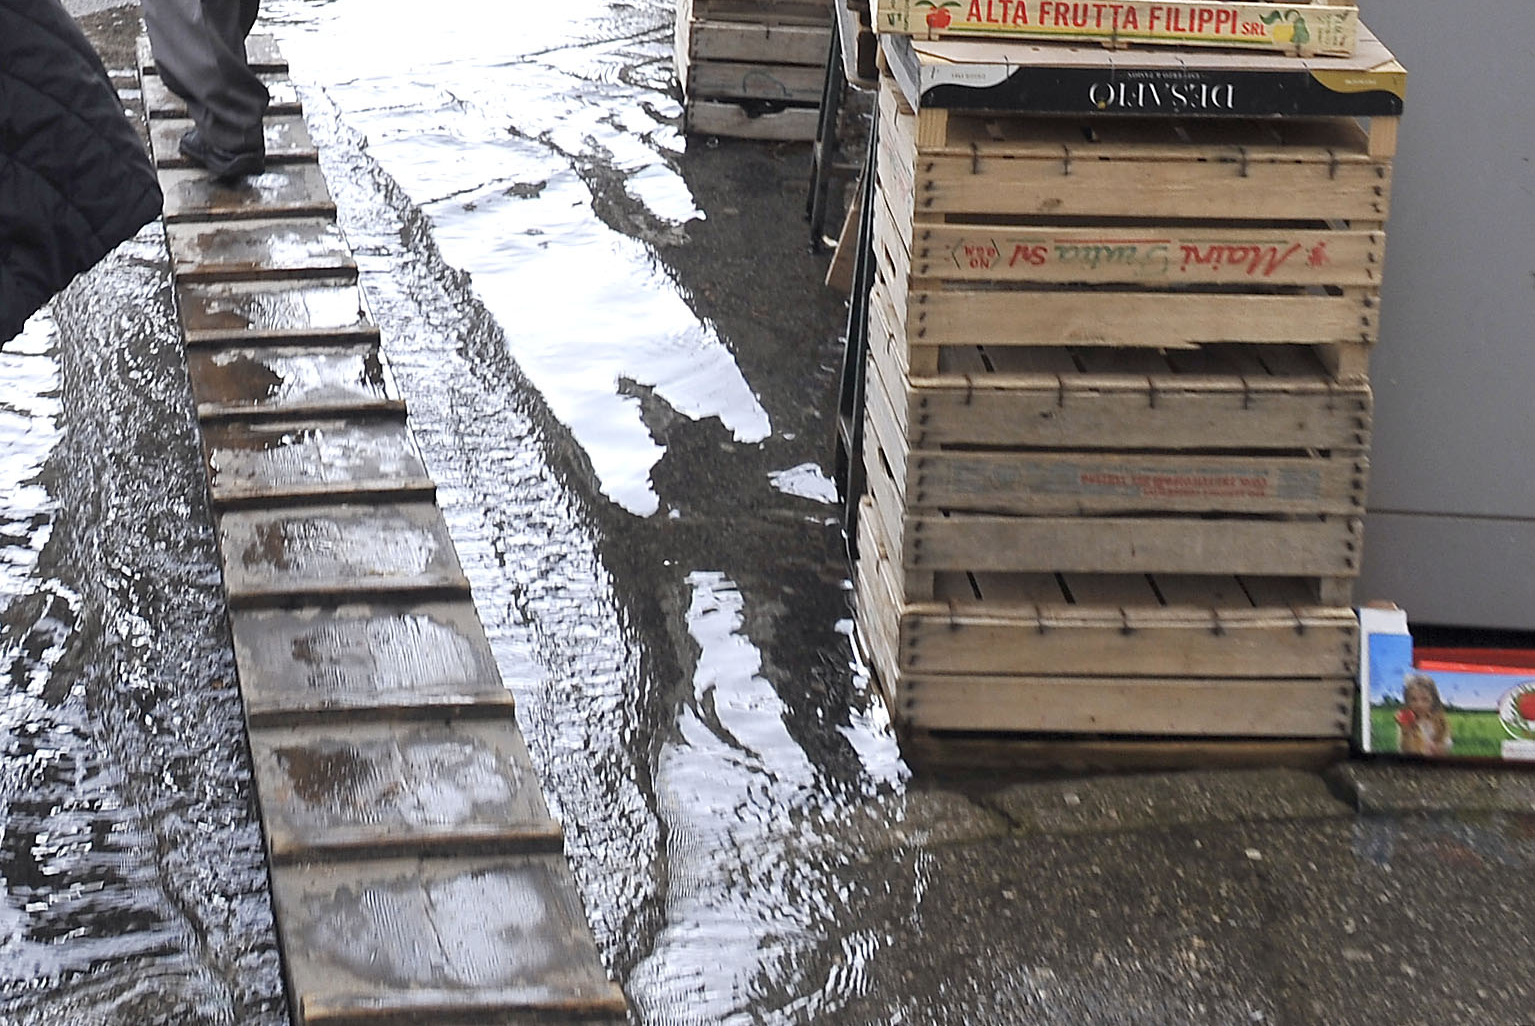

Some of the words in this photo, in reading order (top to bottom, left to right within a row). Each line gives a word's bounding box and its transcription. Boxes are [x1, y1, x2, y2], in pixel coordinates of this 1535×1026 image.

[1038, 1, 1139, 31] FRUTTA
[1148, 5, 1239, 35] FILIPPI
[1241, 21, 1267, 37] SRL
[1179, 242, 1301, 277] Maini
